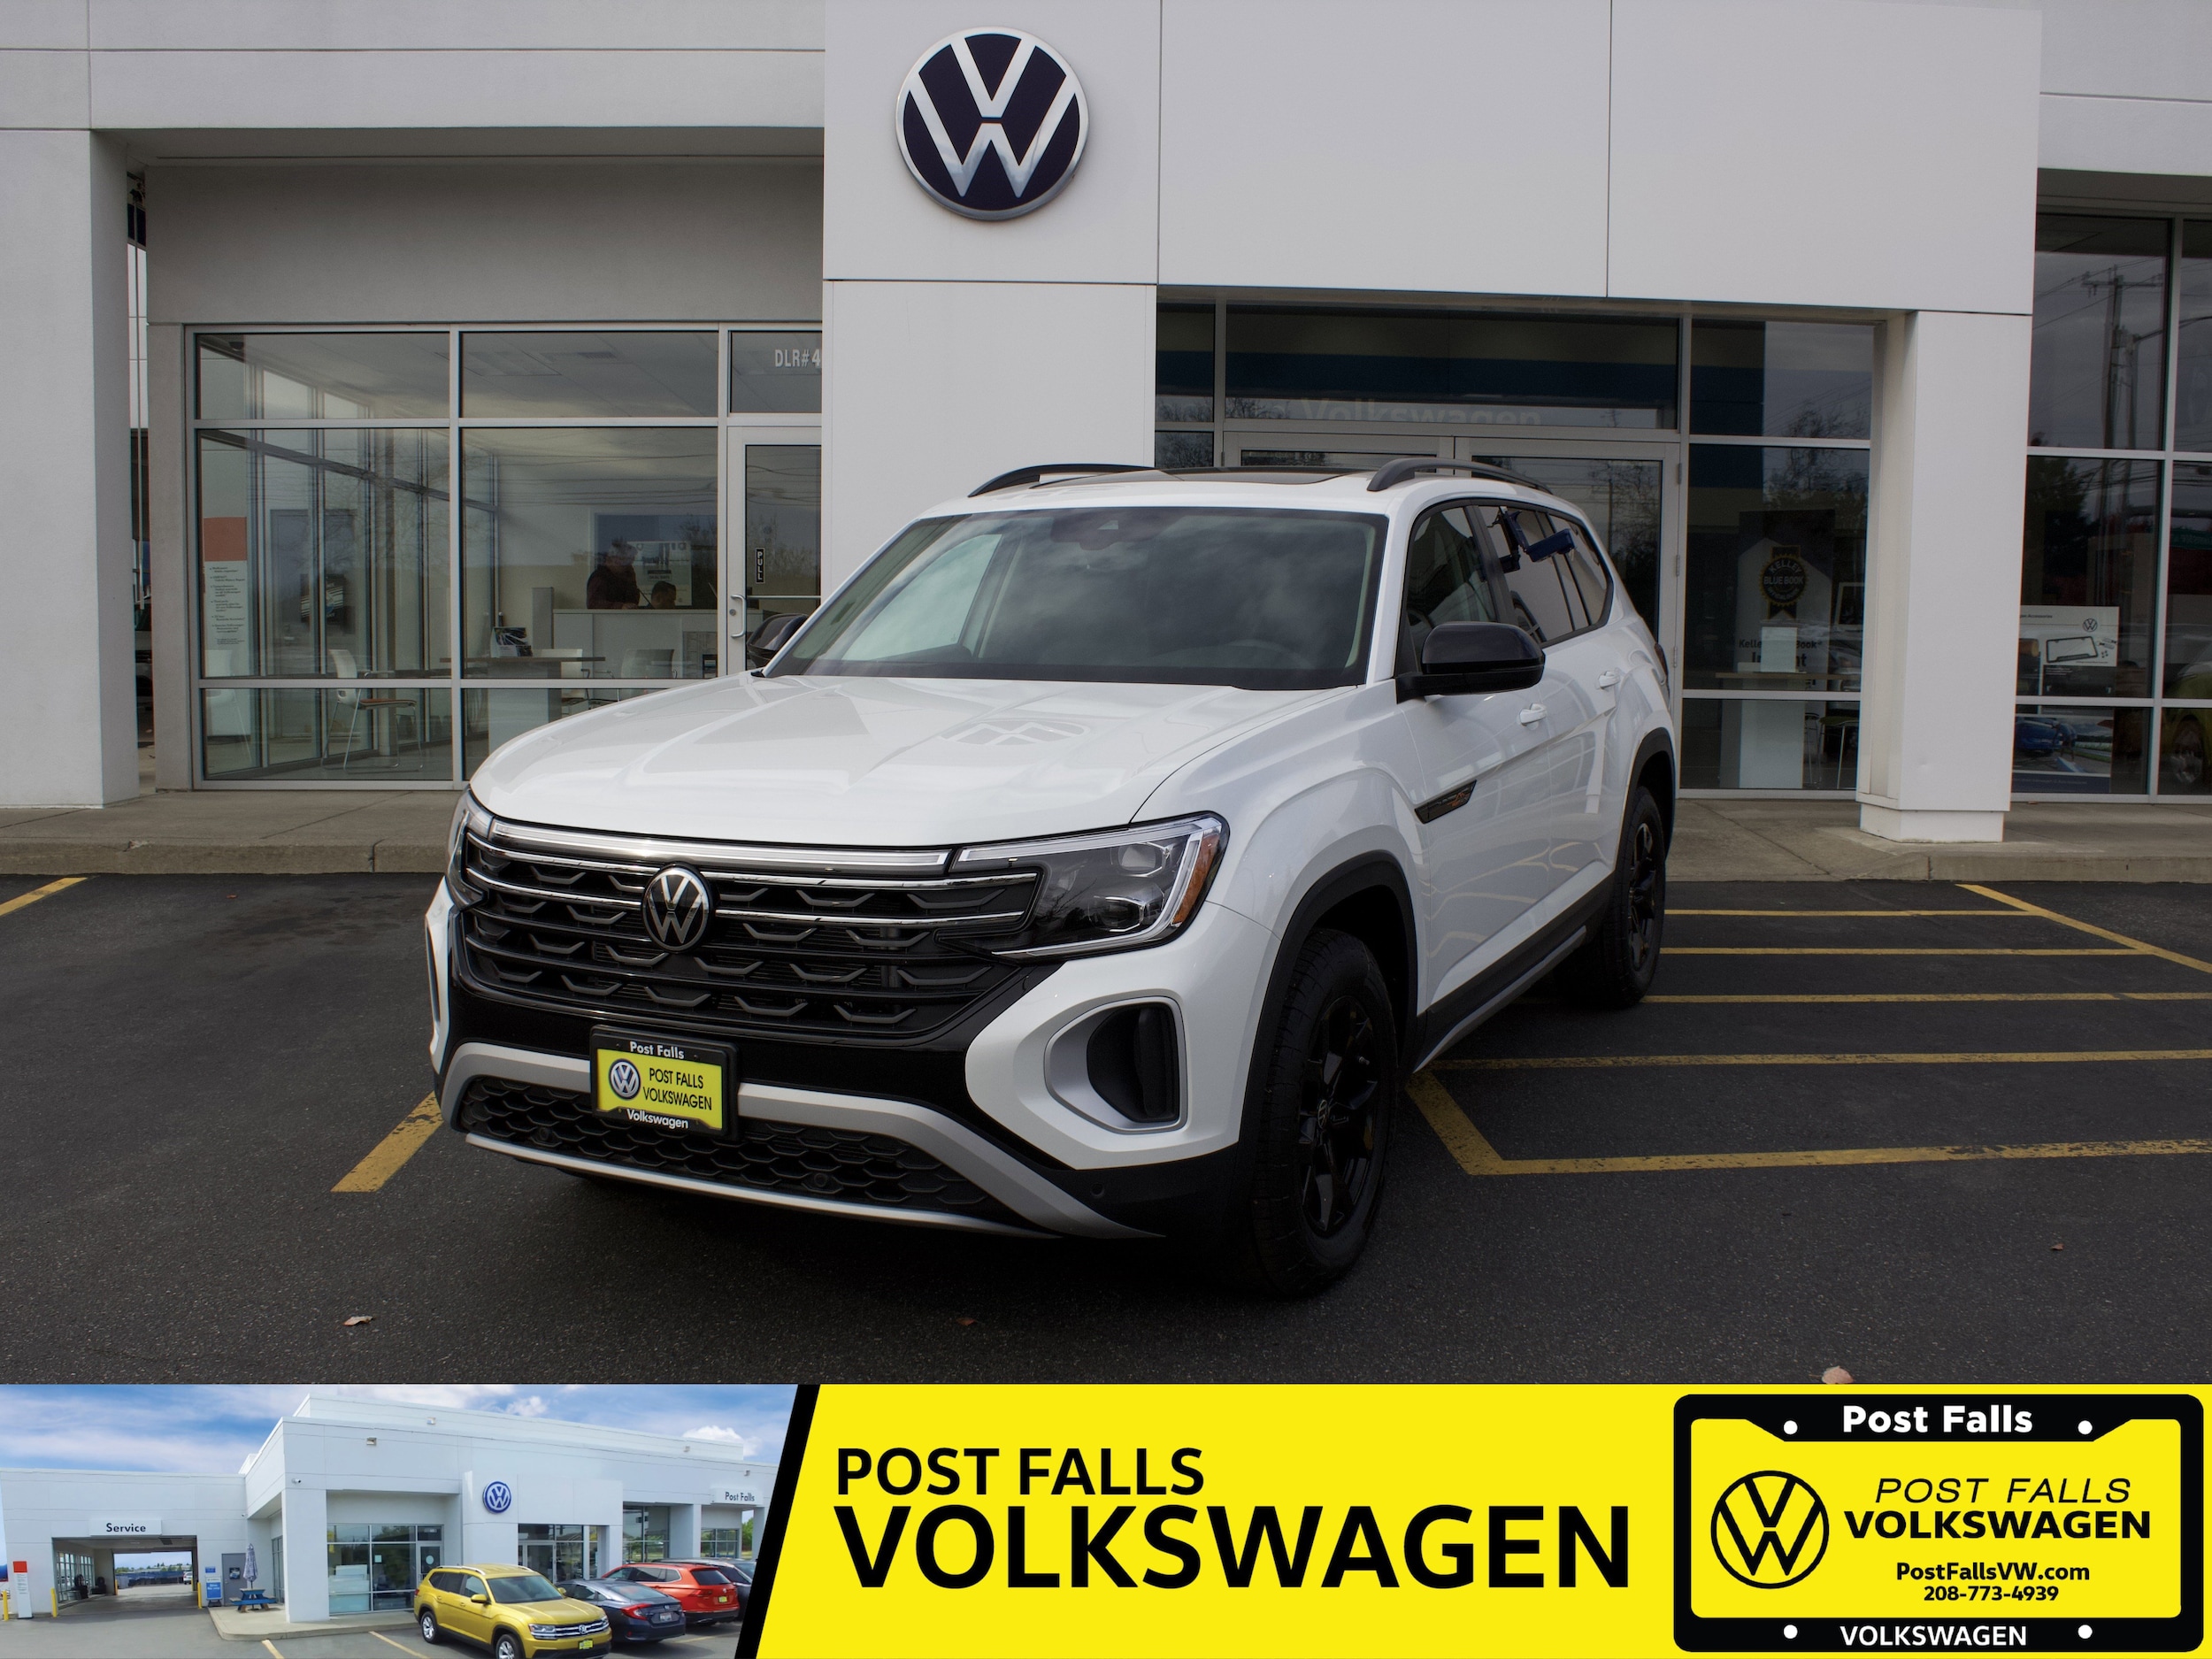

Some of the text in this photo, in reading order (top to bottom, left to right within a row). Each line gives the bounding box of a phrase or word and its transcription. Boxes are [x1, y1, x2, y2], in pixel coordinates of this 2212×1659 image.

[1768, 559, 1802, 574] KELLEY
[1763, 576, 1804, 585] BLUE BOOK
[1739, 639, 1762, 649] Kelle
[629, 1041, 685, 1060] Post Falls
[649, 1068, 703, 1088] POST FALLS
[643, 1087, 711, 1110] VOLKSWAGEN
[627, 1109, 688, 1129] Volkswagen
